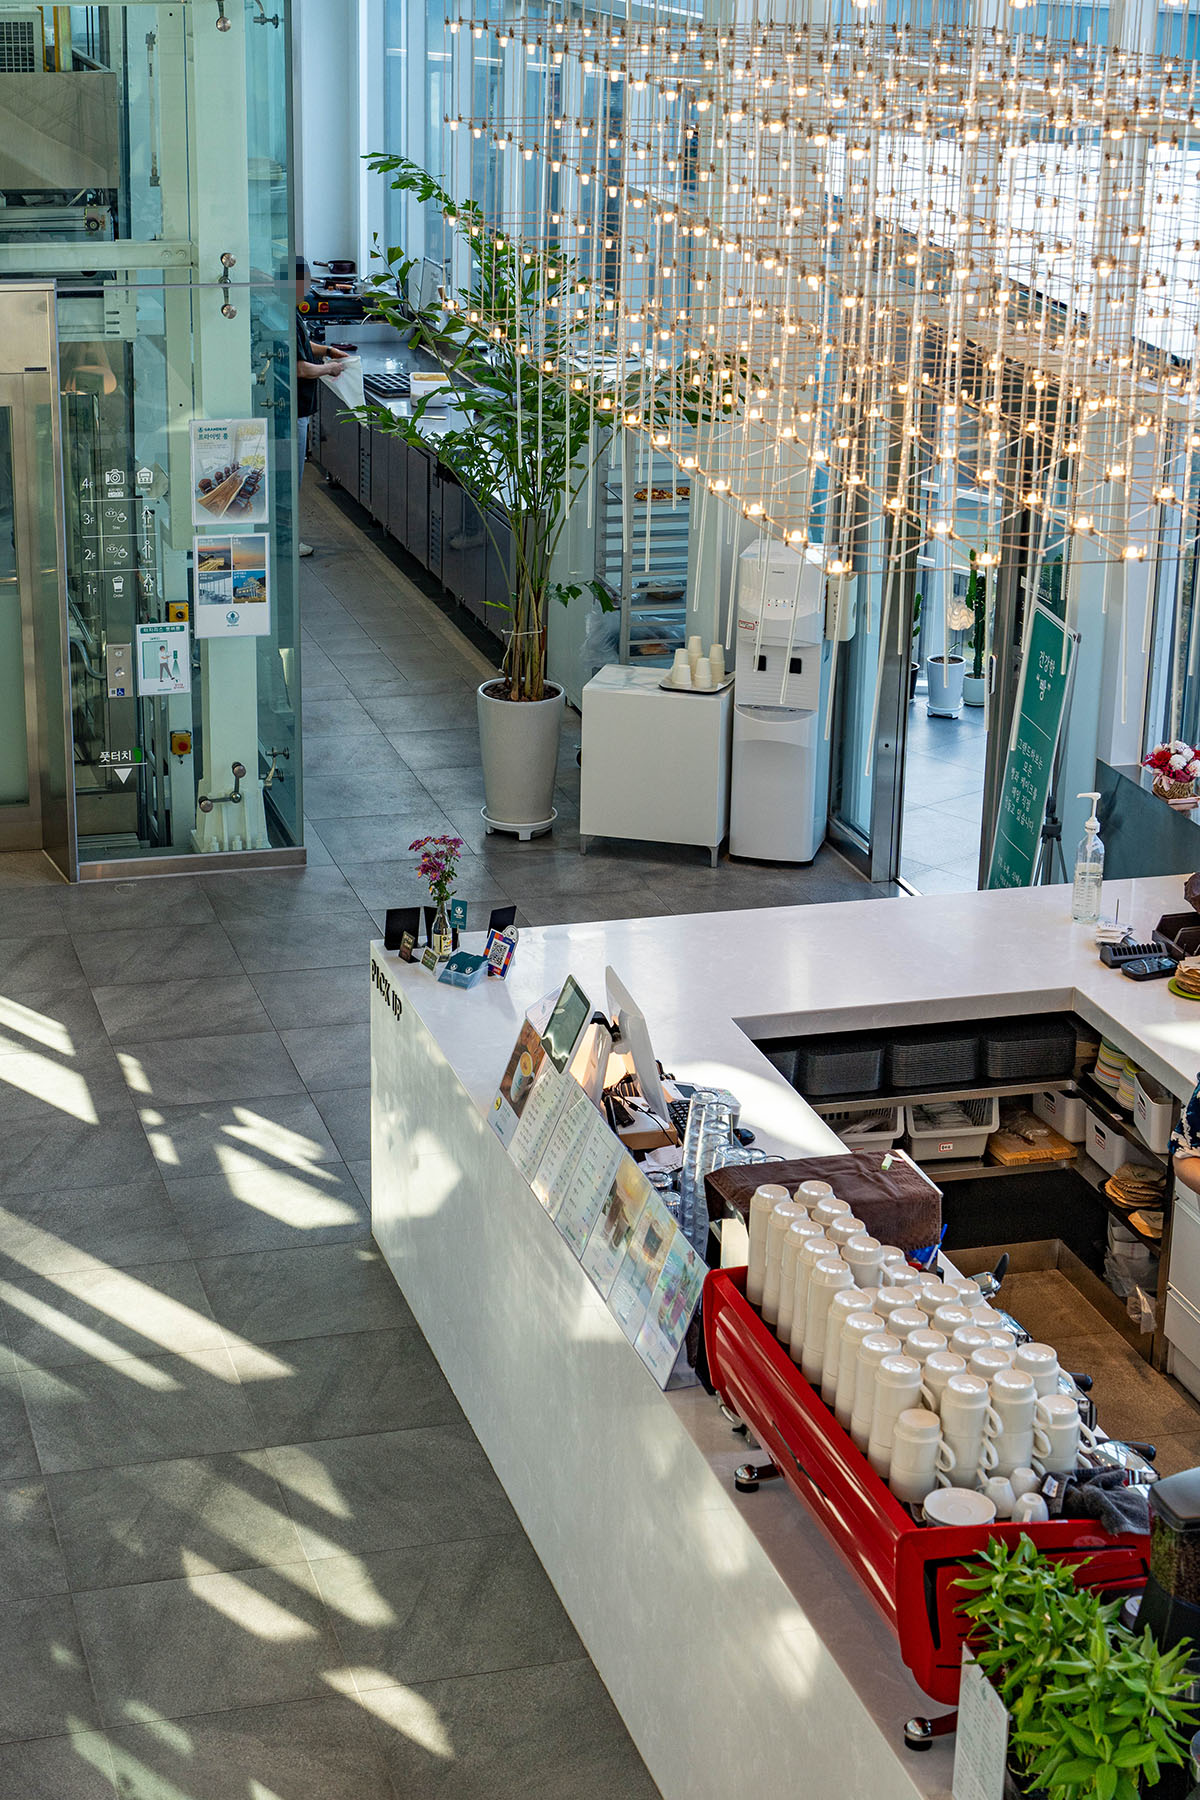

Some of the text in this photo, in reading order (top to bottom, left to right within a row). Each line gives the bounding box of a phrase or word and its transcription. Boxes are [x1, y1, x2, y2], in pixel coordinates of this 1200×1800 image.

[82, 478, 93, 489] 4F
[83, 513, 95, 525] 3F
[84, 549, 96, 560] 2F
[87, 583, 97, 595] 1F
[1039, 651, 1056, 678] 건강한
[100, 750, 132, 763] 풋터치
[1022, 761, 1033, 778] 모든
[1011, 786, 1021, 803] 매일
[1021, 777, 1038, 801] 케이크를
[371, 959, 403, 1021] PICK UP
